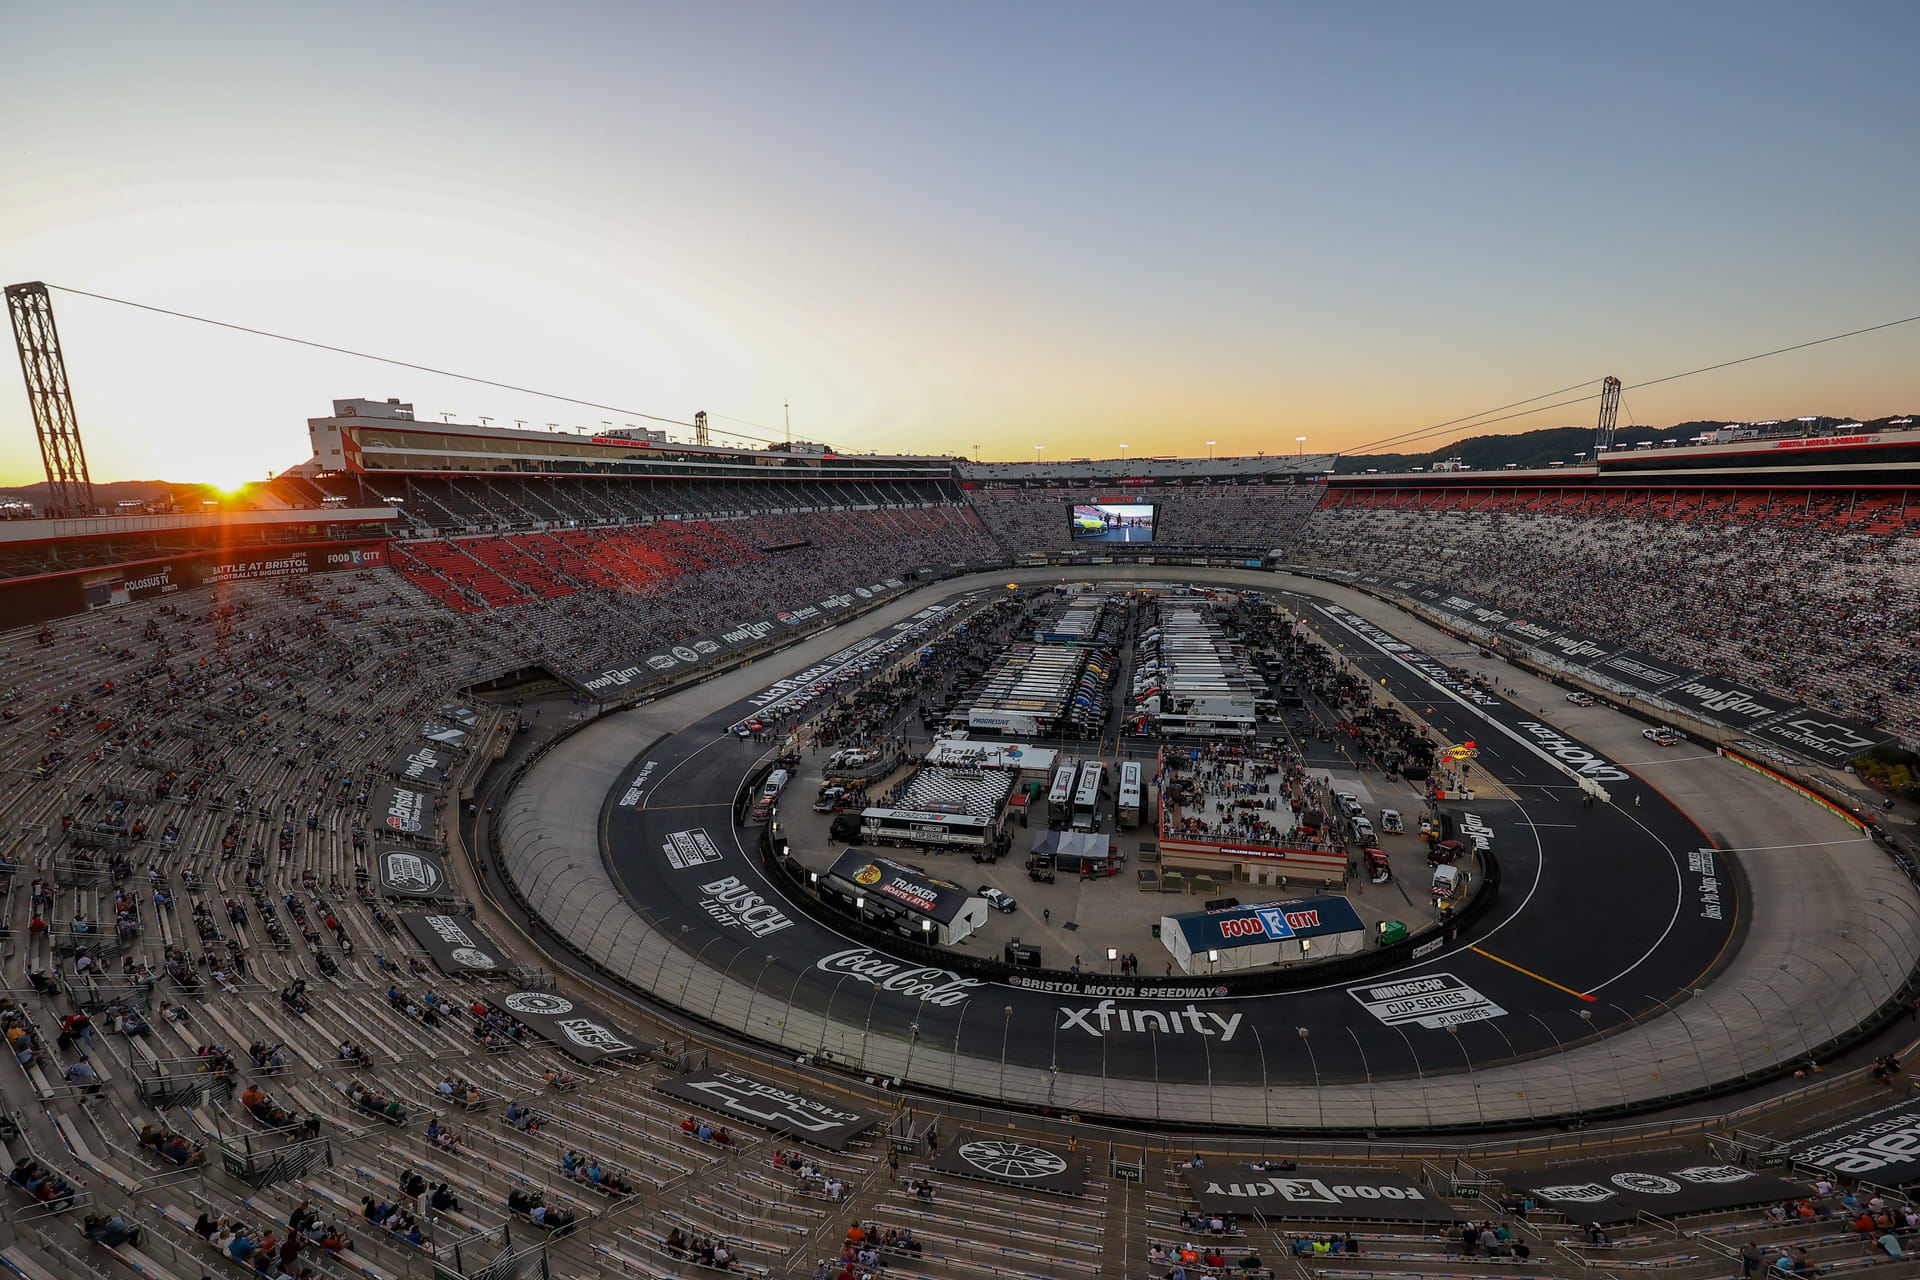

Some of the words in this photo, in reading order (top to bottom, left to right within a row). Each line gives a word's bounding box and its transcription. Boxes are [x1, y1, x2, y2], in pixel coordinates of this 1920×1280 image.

[1831, 436, 1869, 445] SPEEDWAY
[213, 563, 245, 575] BATTLE
[248, 562, 262, 571] AT
[265, 559, 309, 570] BRISTOL
[327, 553, 350, 564] FOOD
[362, 552, 380, 560] CITY
[125, 577, 159, 591] COLOSSUS
[160, 575, 169, 585] TV
[722, 631, 749, 643] FOOD
[756, 621, 775, 631] CITY
[1523, 623, 1556, 637] Bristol
[1551, 636, 1579, 648] FOOD
[1580, 645, 1608, 658] CITY
[584, 678, 612, 691] FOOD
[623, 666, 642, 678] CITY
[795, 664, 828, 681] FOOD
[749, 687, 782, 706] CITY
[1679, 683, 1721, 699] FOOD
[1731, 702, 1776, 718] CITY
[972, 718, 1010, 726] PROGRESSIVE
[1769, 726, 1849, 757] CHEVROLET
[405, 763, 426, 777] FOOD
[417, 747, 436, 760] CITY
[1446, 750, 1478, 758] SUNOCO
[388, 787, 413, 819] Bristol
[891, 878, 938, 902] TRACKER
[1699, 877, 1722, 893] Shops
[698, 875, 795, 938] BUSCH
[882, 885, 907, 899] BOATS
[911, 898, 930, 909] ATVs
[1701, 893, 1721, 905] Pro
[699, 899, 740, 927] LIGHT
[1701, 905, 1722, 920] Bass
[1220, 918, 1263, 938] FOOD
[1285, 910, 1320, 929] CITY
[1021, 977, 1080, 994] BRISTOL
[1084, 985, 1136, 997] MOTOR
[1139, 987, 1216, 998] SPEEDWAY
[1388, 979, 1447, 998] NASCAR
[1386, 1001, 1416, 1014] CUP
[1418, 992, 1467, 1009] SERIES
[1059, 1000, 1243, 1041] xfinity
[1438, 1009, 1492, 1025] PLAYOFFS
[563, 1019, 627, 1052] BUSH'S
[712, 1072, 861, 1121] CHEVROLET
[1790, 1130, 1876, 1163] HEATERS
[1679, 1166, 1746, 1182] BUSH'S
[1203, 1182, 1276, 1196] CITY
[1332, 1185, 1426, 1200] FOOD
[1542, 1184, 1607, 1199] BUSH'S
